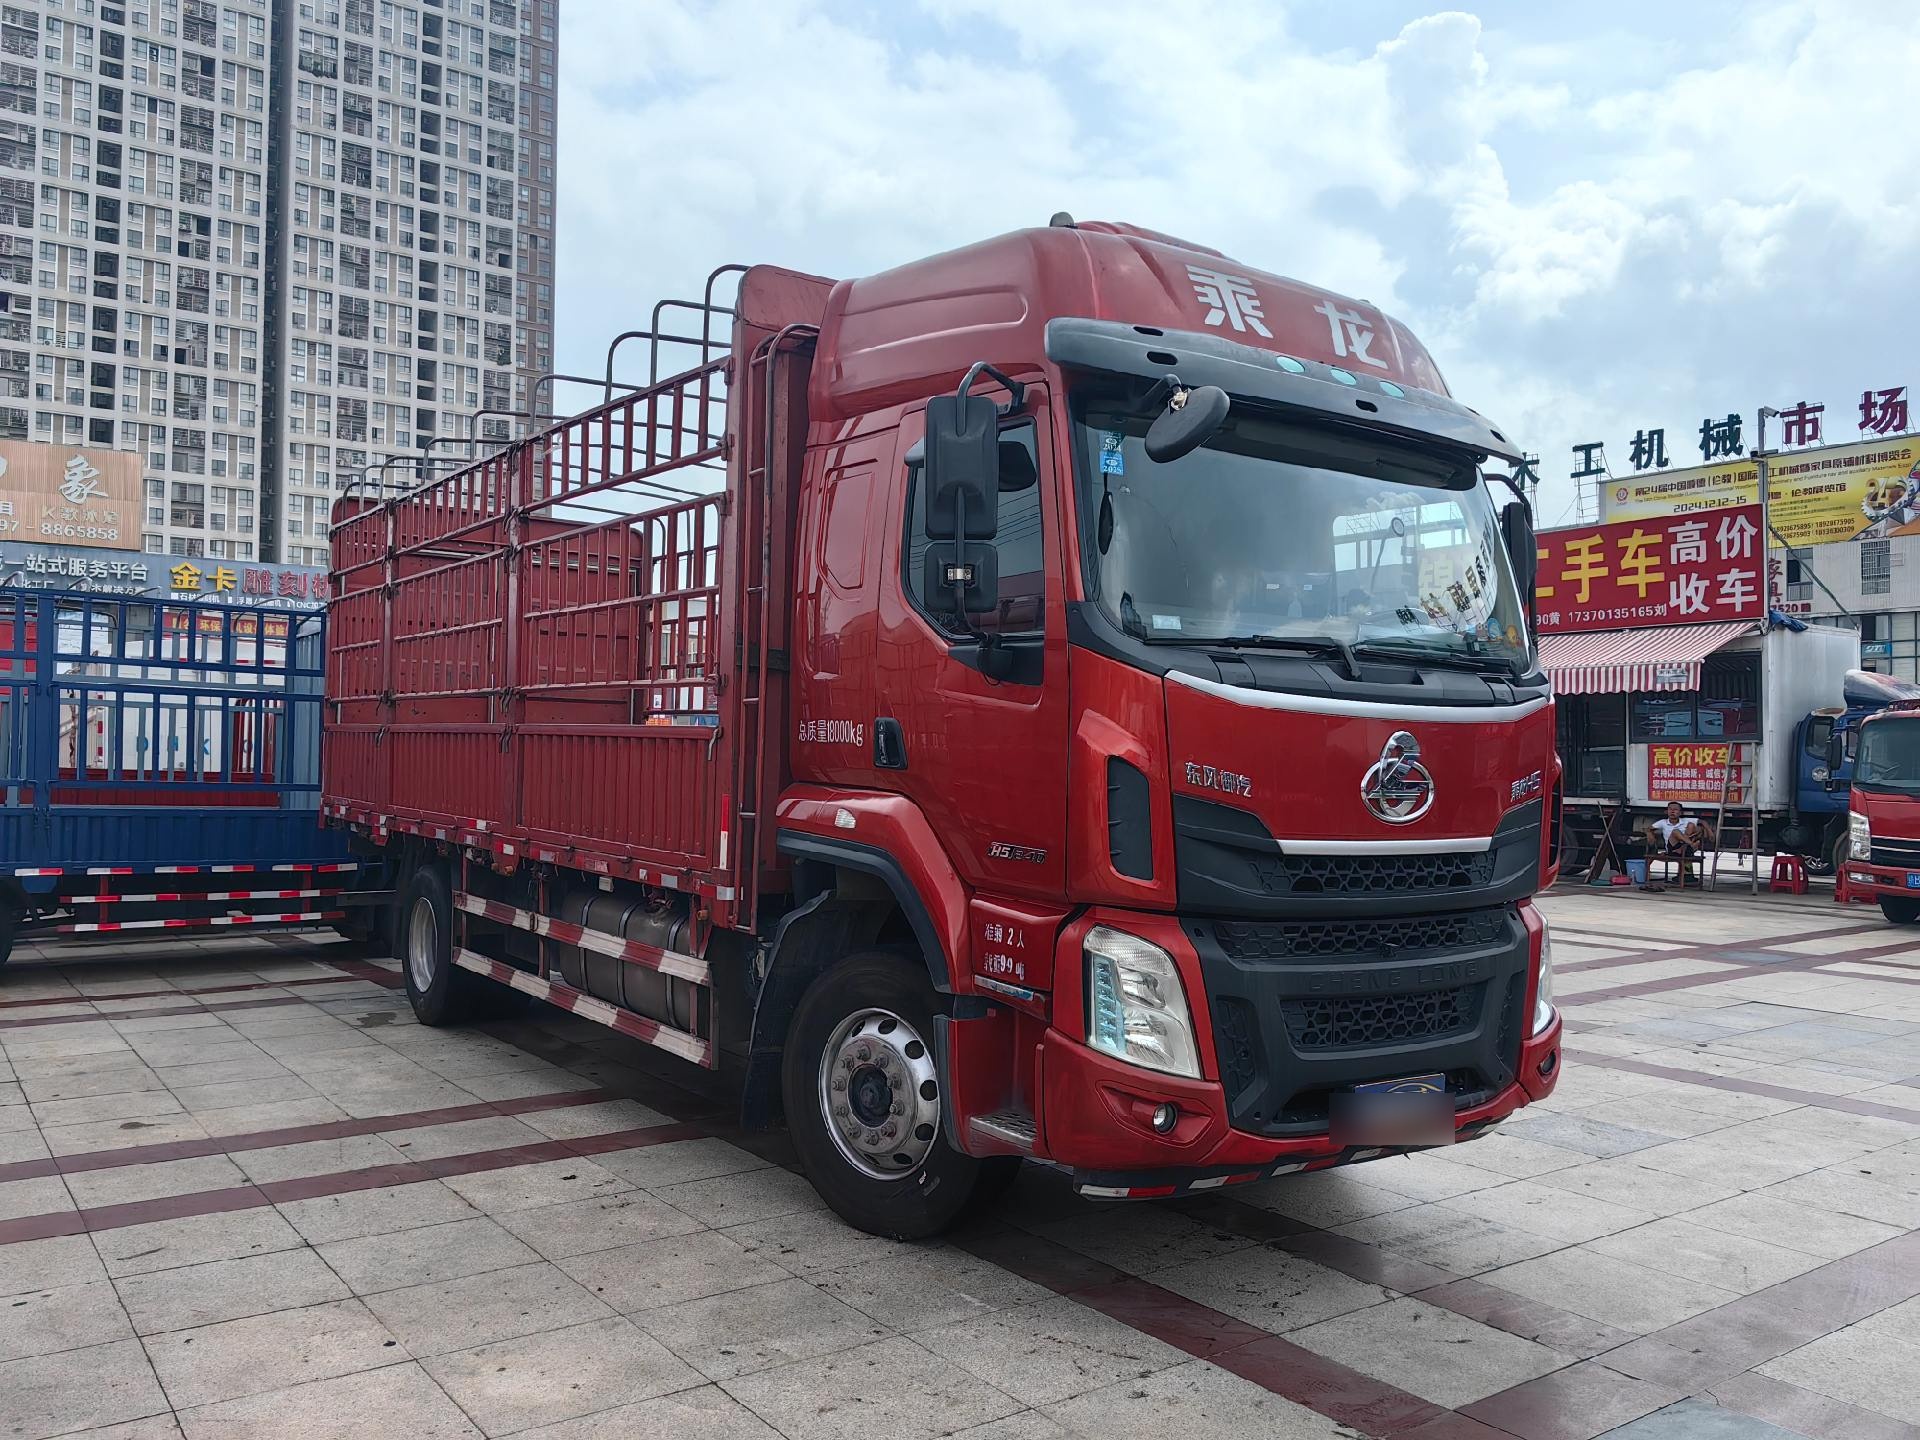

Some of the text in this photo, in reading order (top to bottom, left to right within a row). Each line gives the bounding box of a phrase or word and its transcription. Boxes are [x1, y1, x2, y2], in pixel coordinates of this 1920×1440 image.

[1184, 263, 1389, 370] 乘龙
[1668, 514, 1758, 566] 高价
[0, 552, 148, 582] 一站式服务平台
[1668, 567, 1758, 617] 收车
[1568, 603, 1668, 623] 17370135165刘
[798, 719, 864, 747] 总质量18000kg
[1652, 747, 1729, 767] 高价收车
